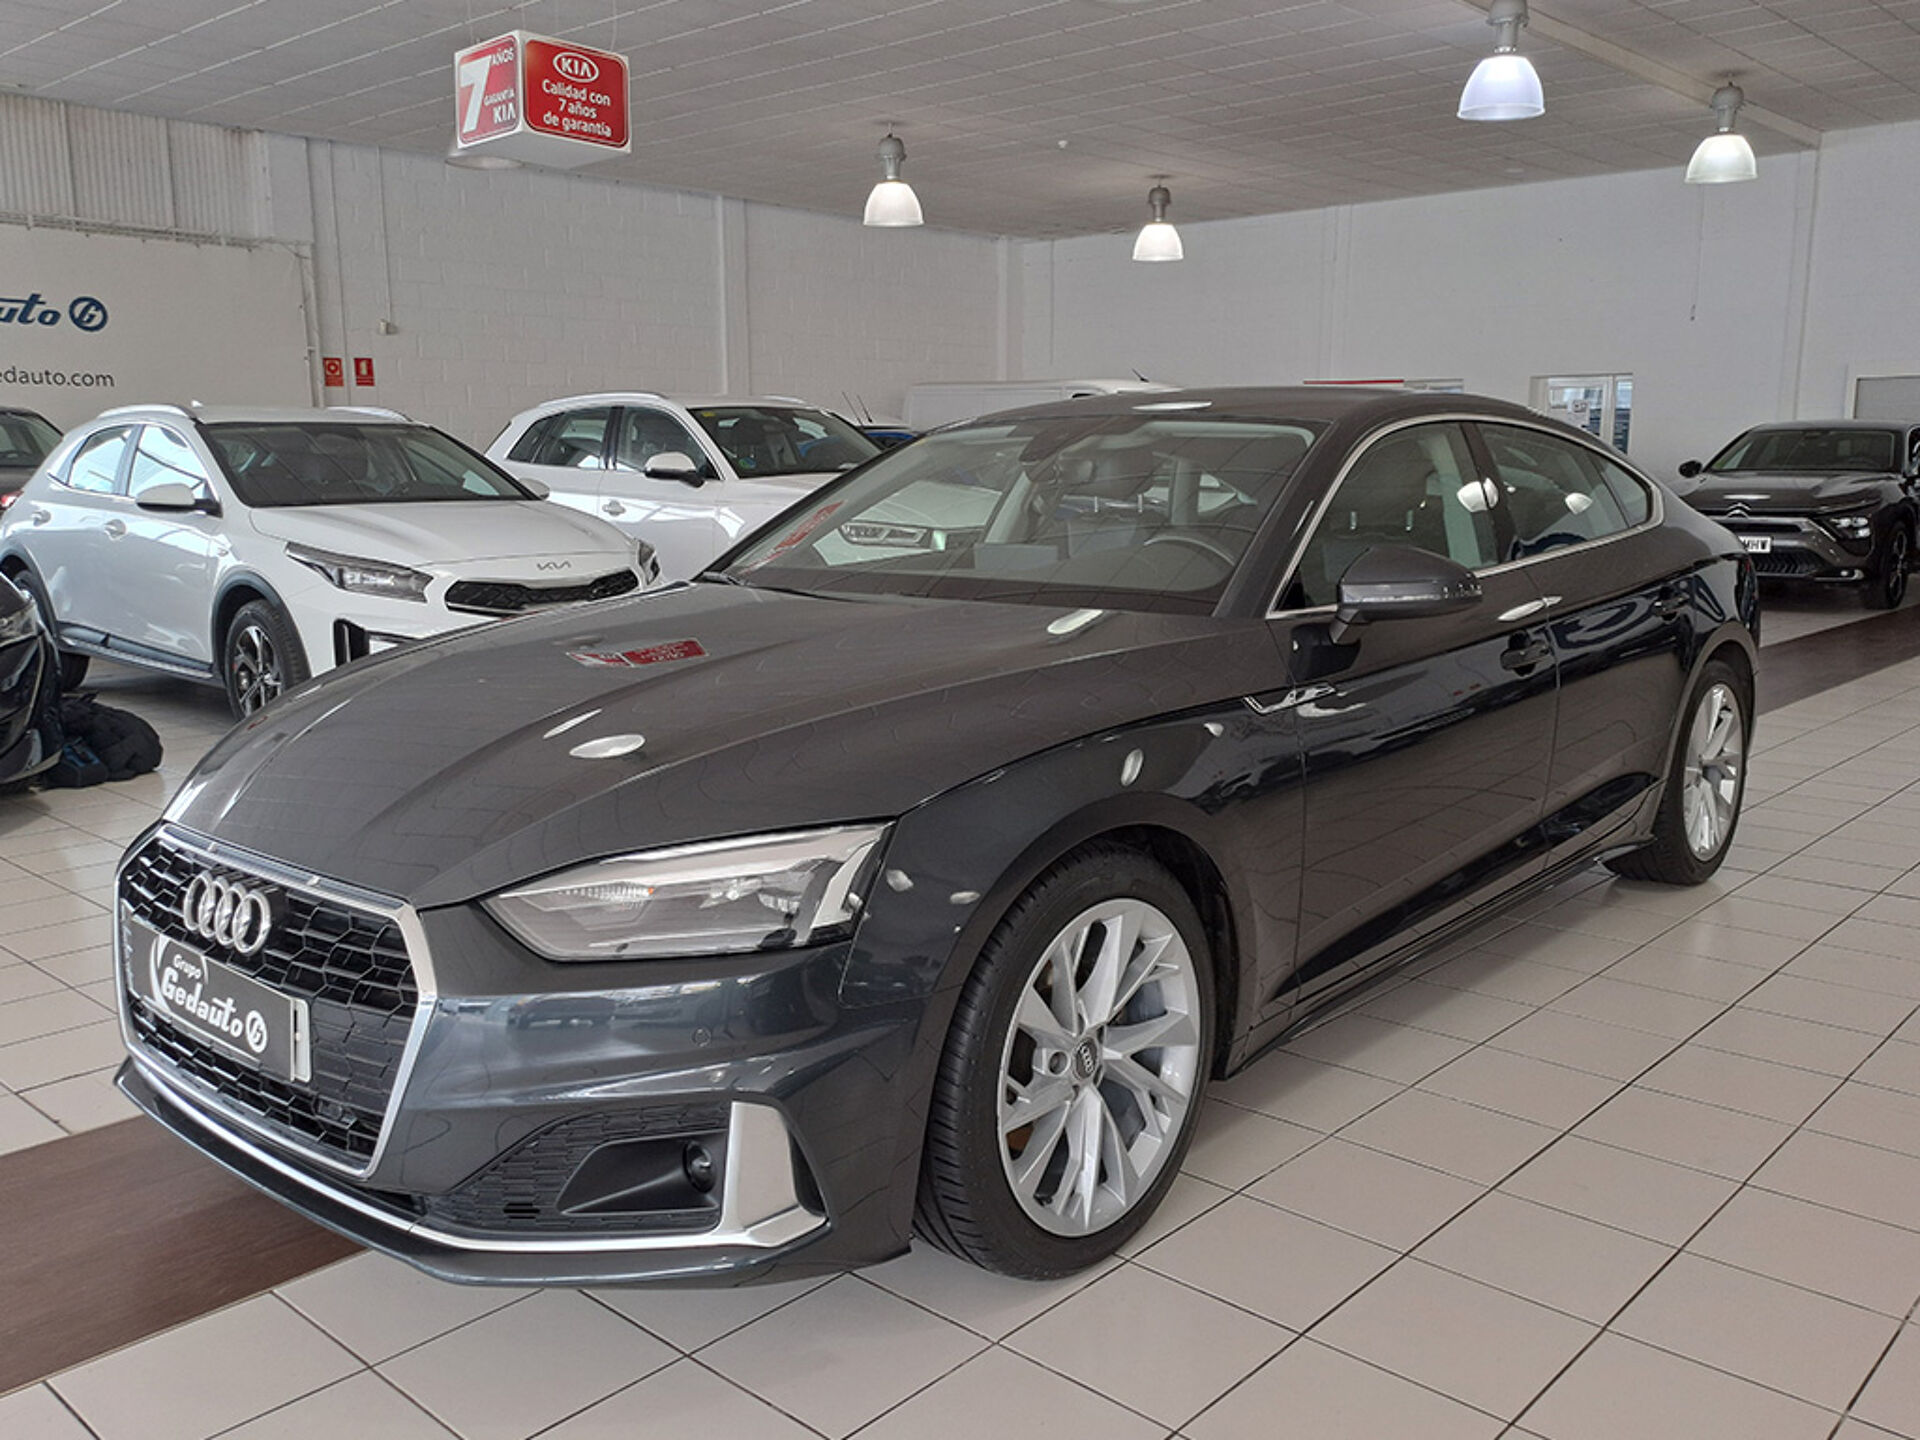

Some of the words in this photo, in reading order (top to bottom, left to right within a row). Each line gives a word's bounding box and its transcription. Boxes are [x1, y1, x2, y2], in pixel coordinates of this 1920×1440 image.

[561, 57, 592, 78] KIA
[460, 55, 491, 133] 7
[542, 79, 587, 101] Calidad
[589, 93, 611, 106] con
[493, 103, 516, 124] KIA
[558, 98, 567, 112] 7
[568, 103, 597, 119] años
[543, 112, 560, 127] de
[0, 366, 115, 387] dauto.com
[172, 954, 202, 979] Grupo
[161, 966, 244, 1038] Gedauto
